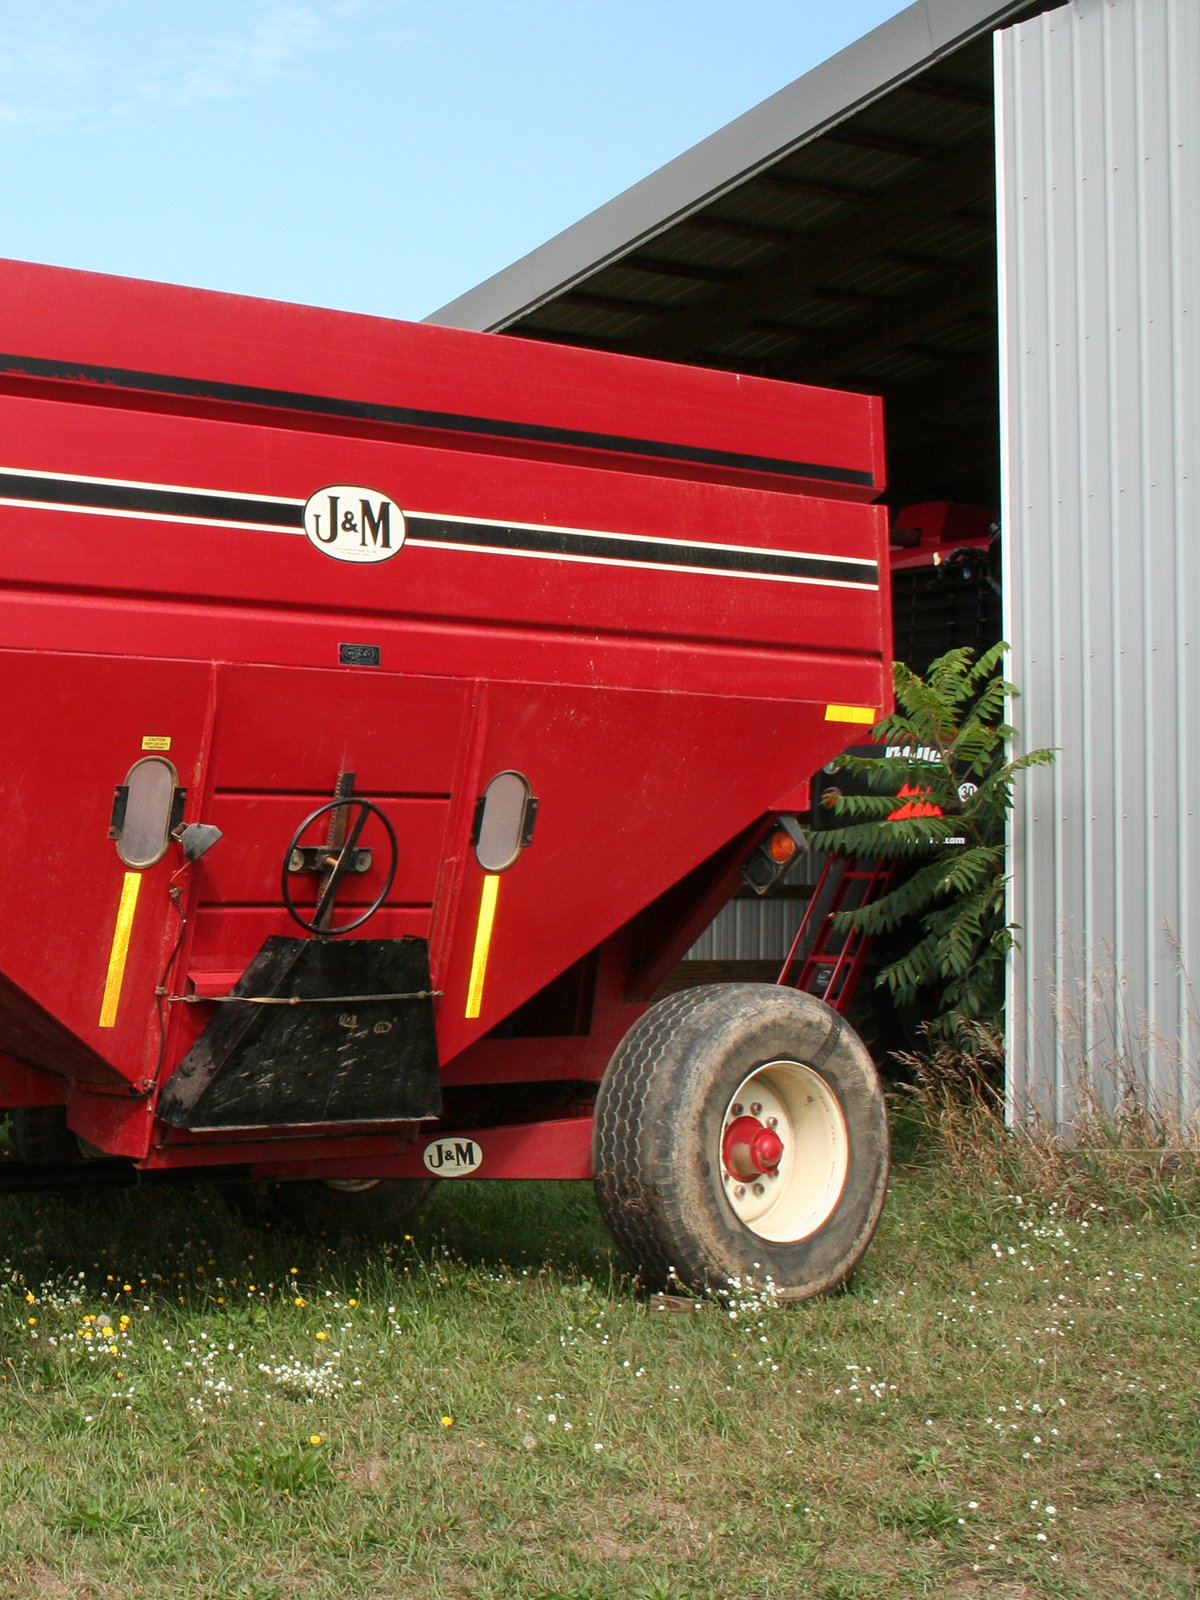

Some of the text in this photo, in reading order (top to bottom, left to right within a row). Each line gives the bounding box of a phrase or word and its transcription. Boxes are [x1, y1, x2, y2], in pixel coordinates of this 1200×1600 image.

[313, 495, 392, 548] J&M
[961, 785, 975, 798] 30
[427, 1142, 476, 1168] J&M
